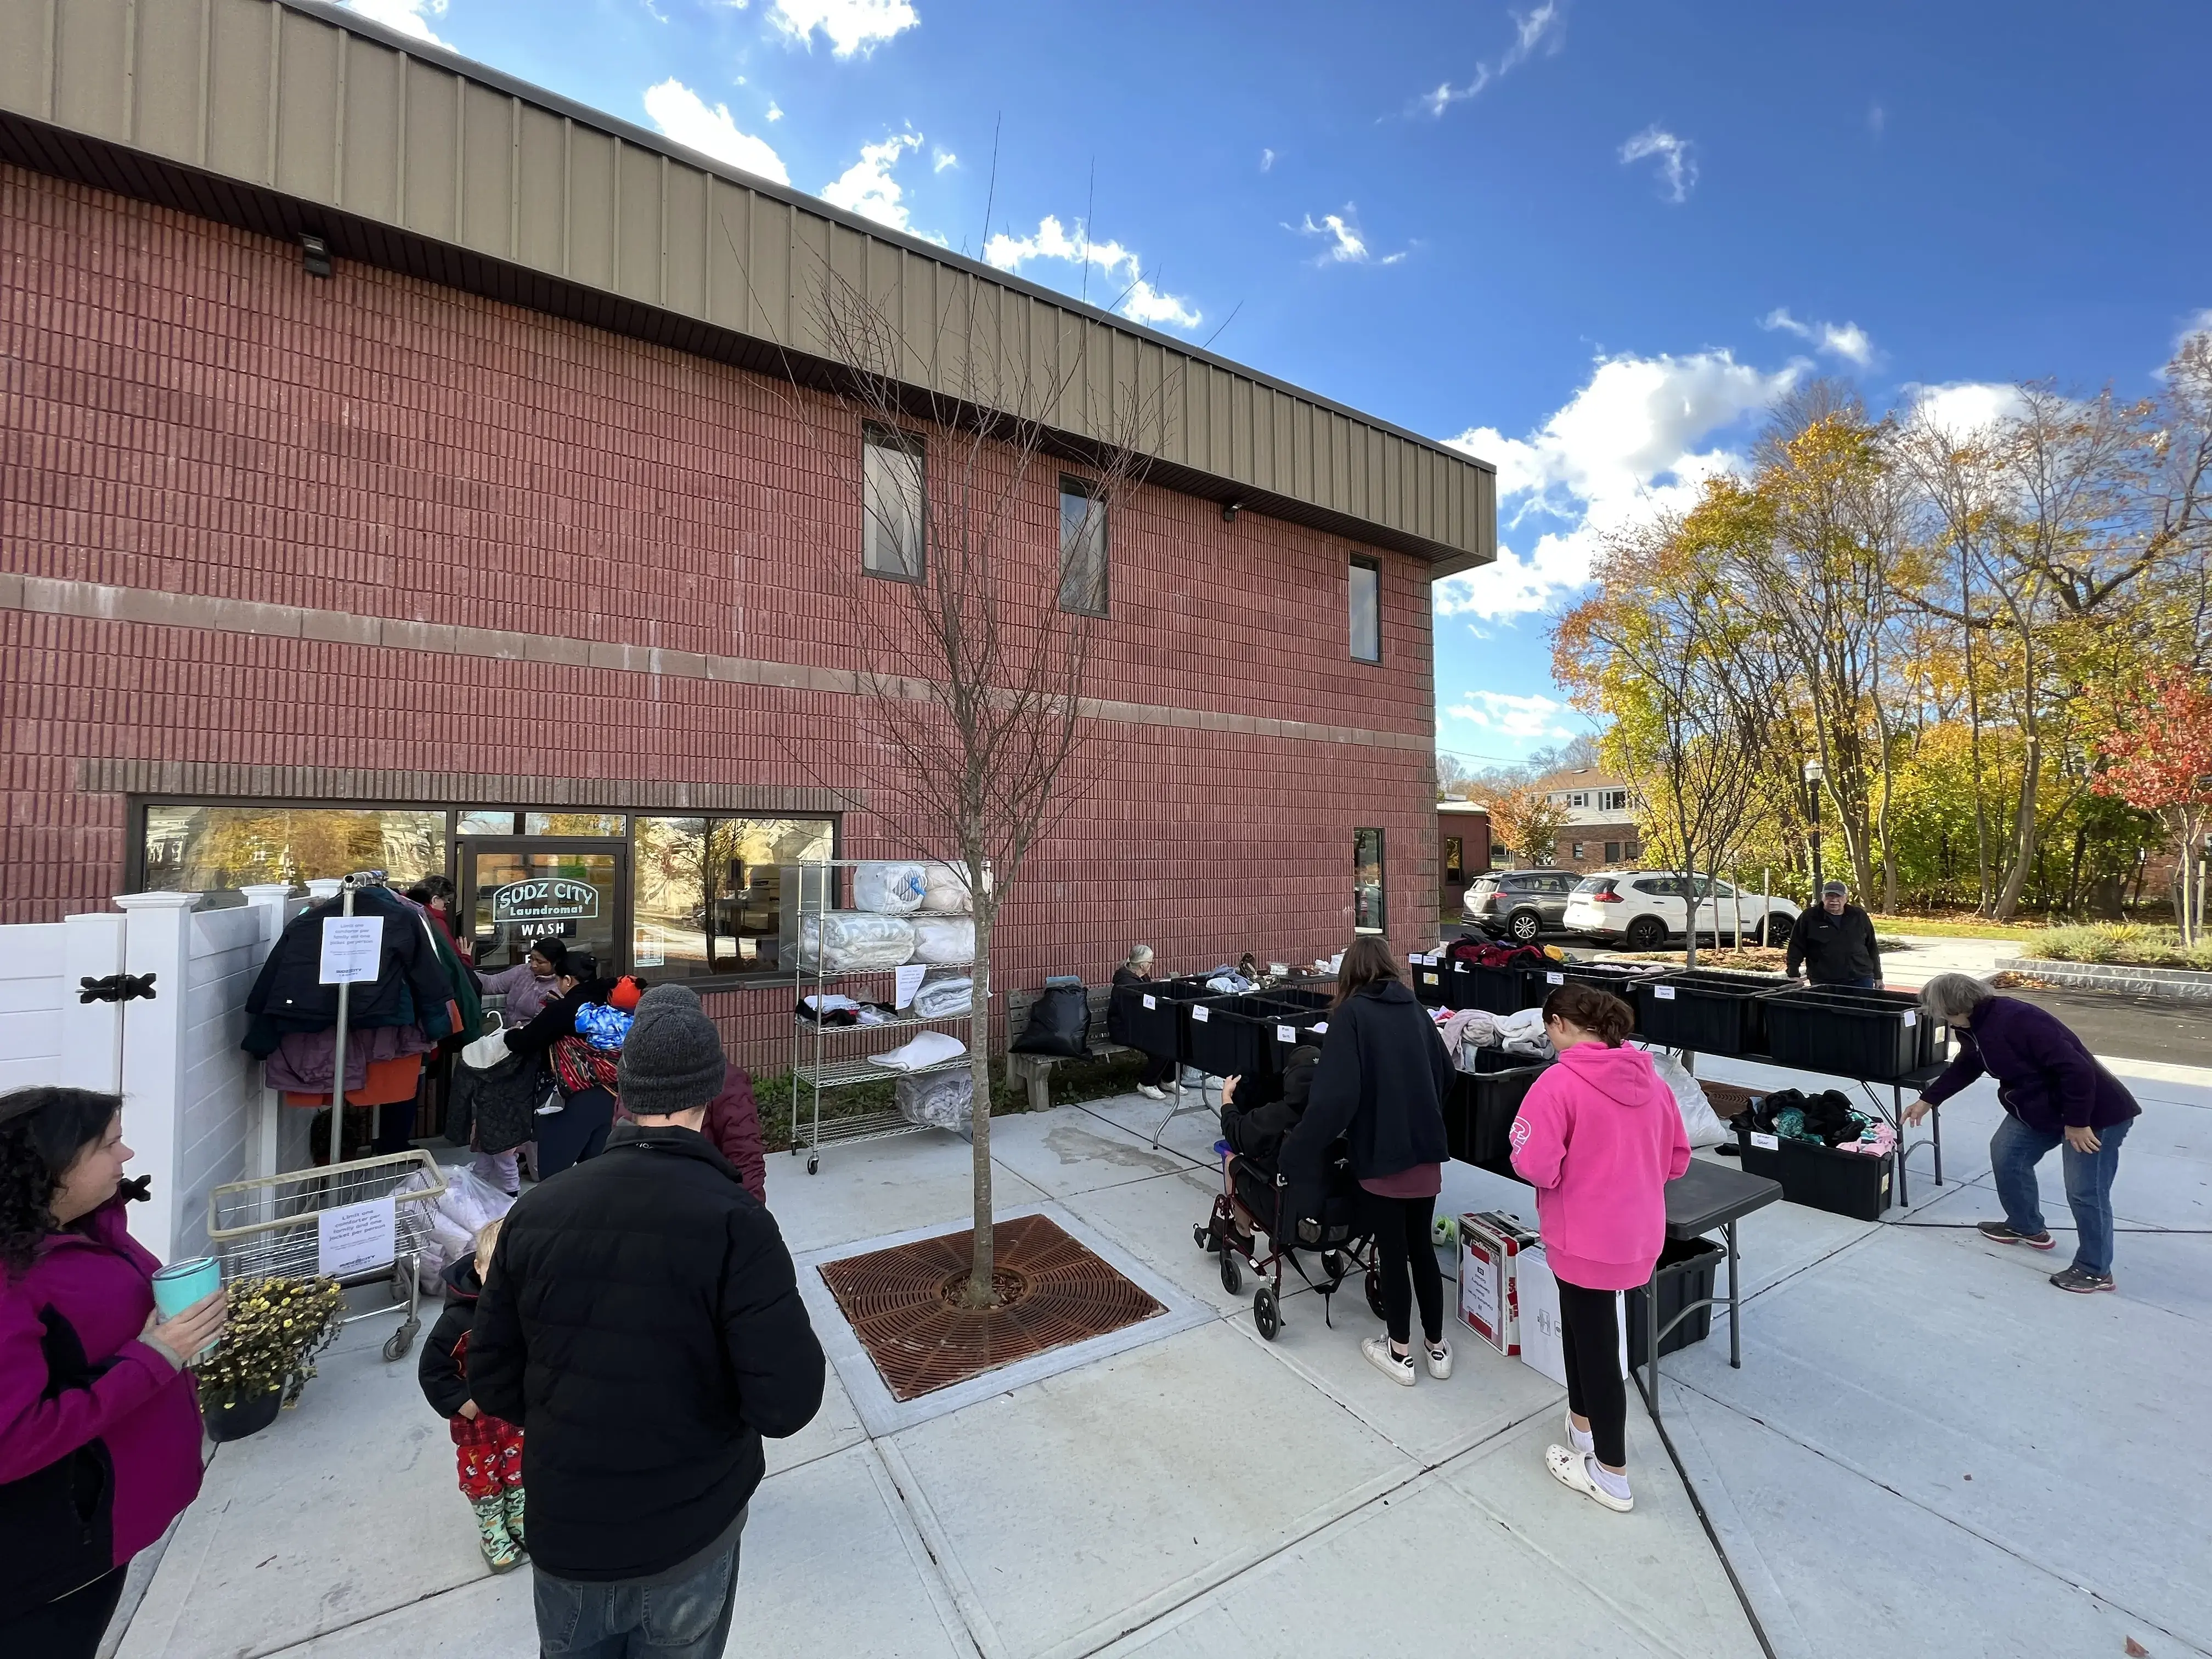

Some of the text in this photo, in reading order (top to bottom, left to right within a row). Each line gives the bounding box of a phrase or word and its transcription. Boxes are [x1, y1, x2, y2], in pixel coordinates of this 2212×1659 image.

[500, 883, 592, 909] SUDZ CITY
[510, 905, 583, 916] Laundromat
[521, 922, 564, 936] WASH
[335, 1217, 368, 1227] comforter
[329, 1232, 349, 1242] jacket
[364, 1224, 386, 1233] person
